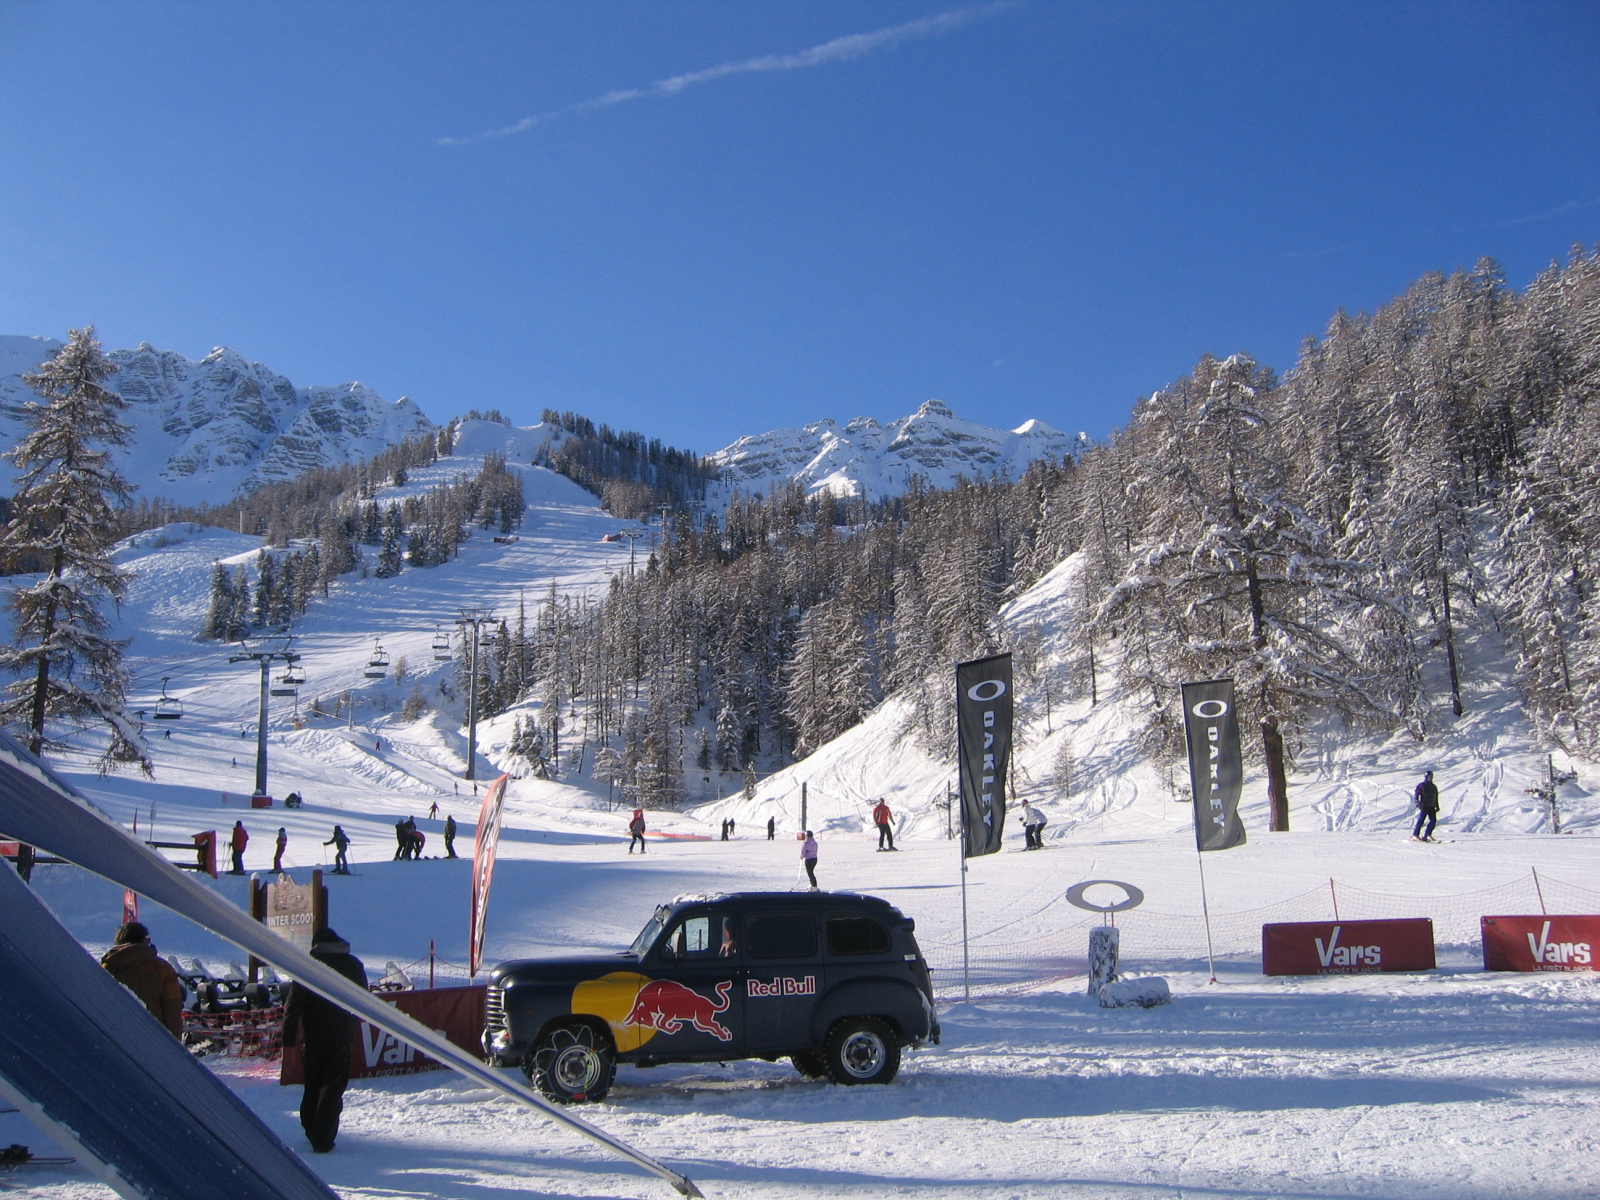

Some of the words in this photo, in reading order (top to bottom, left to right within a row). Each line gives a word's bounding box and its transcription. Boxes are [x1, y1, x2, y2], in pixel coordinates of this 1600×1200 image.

[982, 710, 995, 827] OAKLEY
[1207, 726, 1225, 828] OAKLEY
[1314, 925, 1382, 967] Vars
[1526, 920, 1592, 964] Vars
[747, 977, 781, 997] Red
[783, 975, 815, 996] Bull
